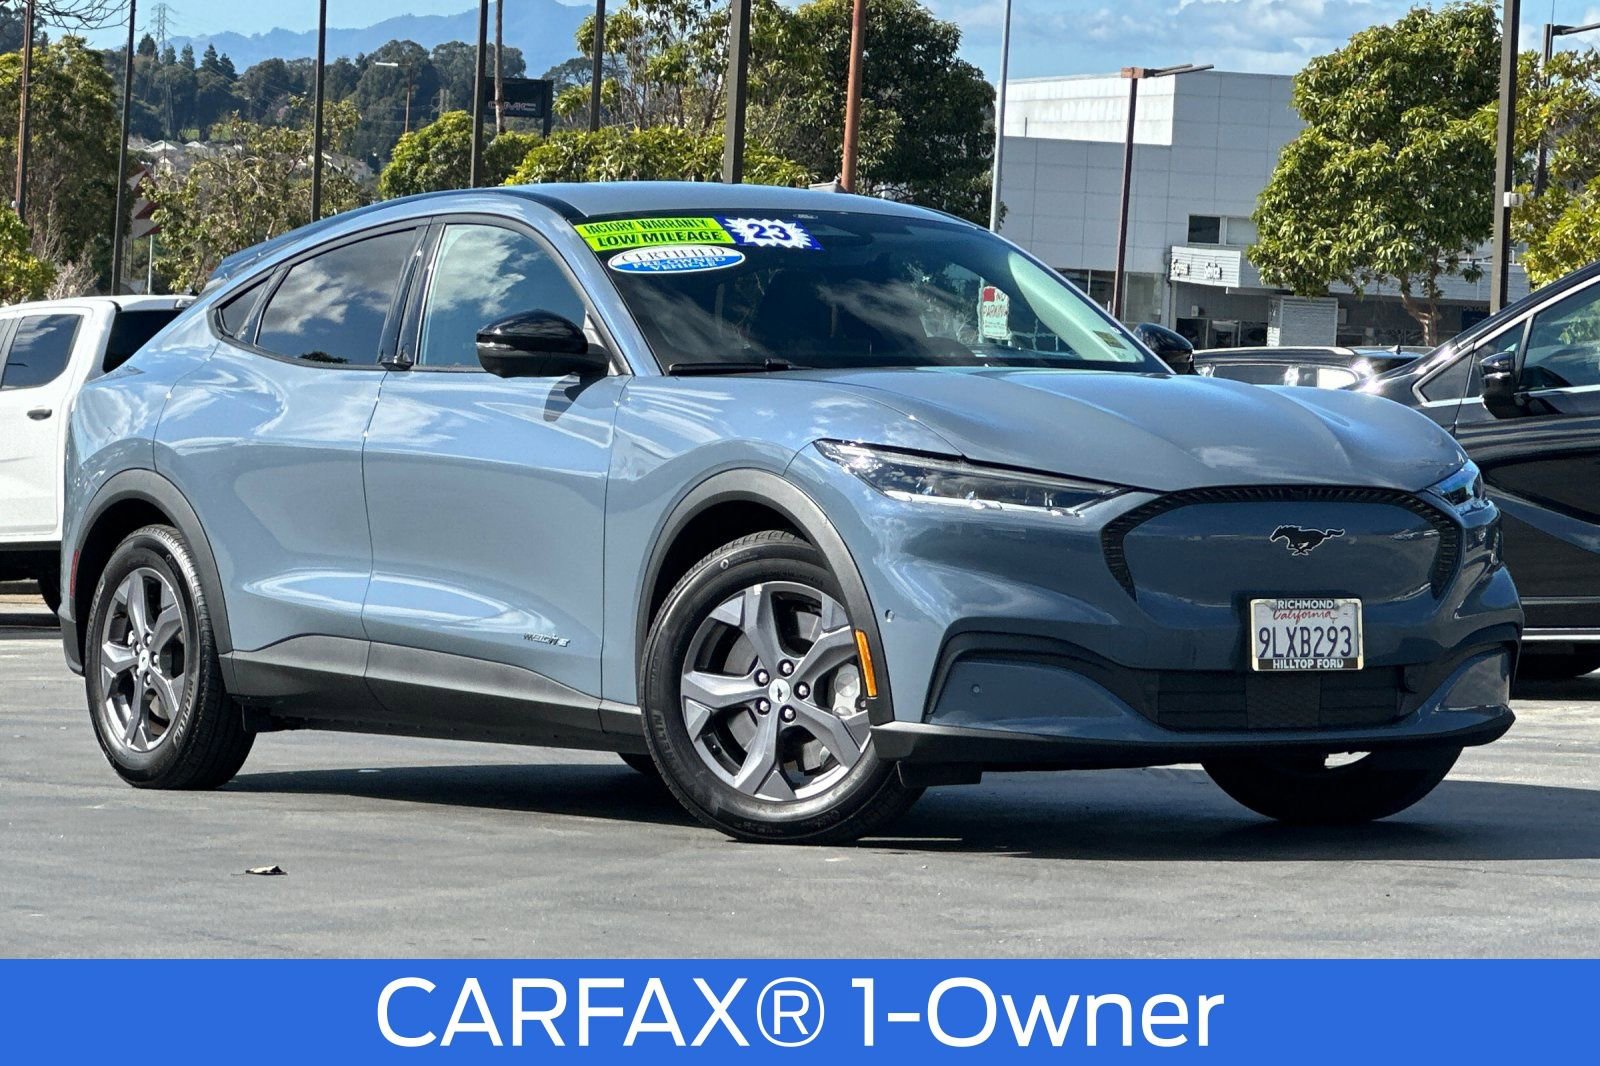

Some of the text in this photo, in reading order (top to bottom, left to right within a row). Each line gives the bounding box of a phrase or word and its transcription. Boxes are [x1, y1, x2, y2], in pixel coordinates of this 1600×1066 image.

[583, 218, 706, 234] FACTORY WARRANTY
[747, 223, 792, 241] 23
[599, 230, 721, 247] LOW MILEAGE
[622, 248, 726, 261] CERTIFIED
[1277, 600, 1334, 609] RICHMOND
[1273, 609, 1335, 625] California
[1259, 626, 1352, 658] 9LXB293
[1272, 659, 1344, 669] HILLTOP FORD
